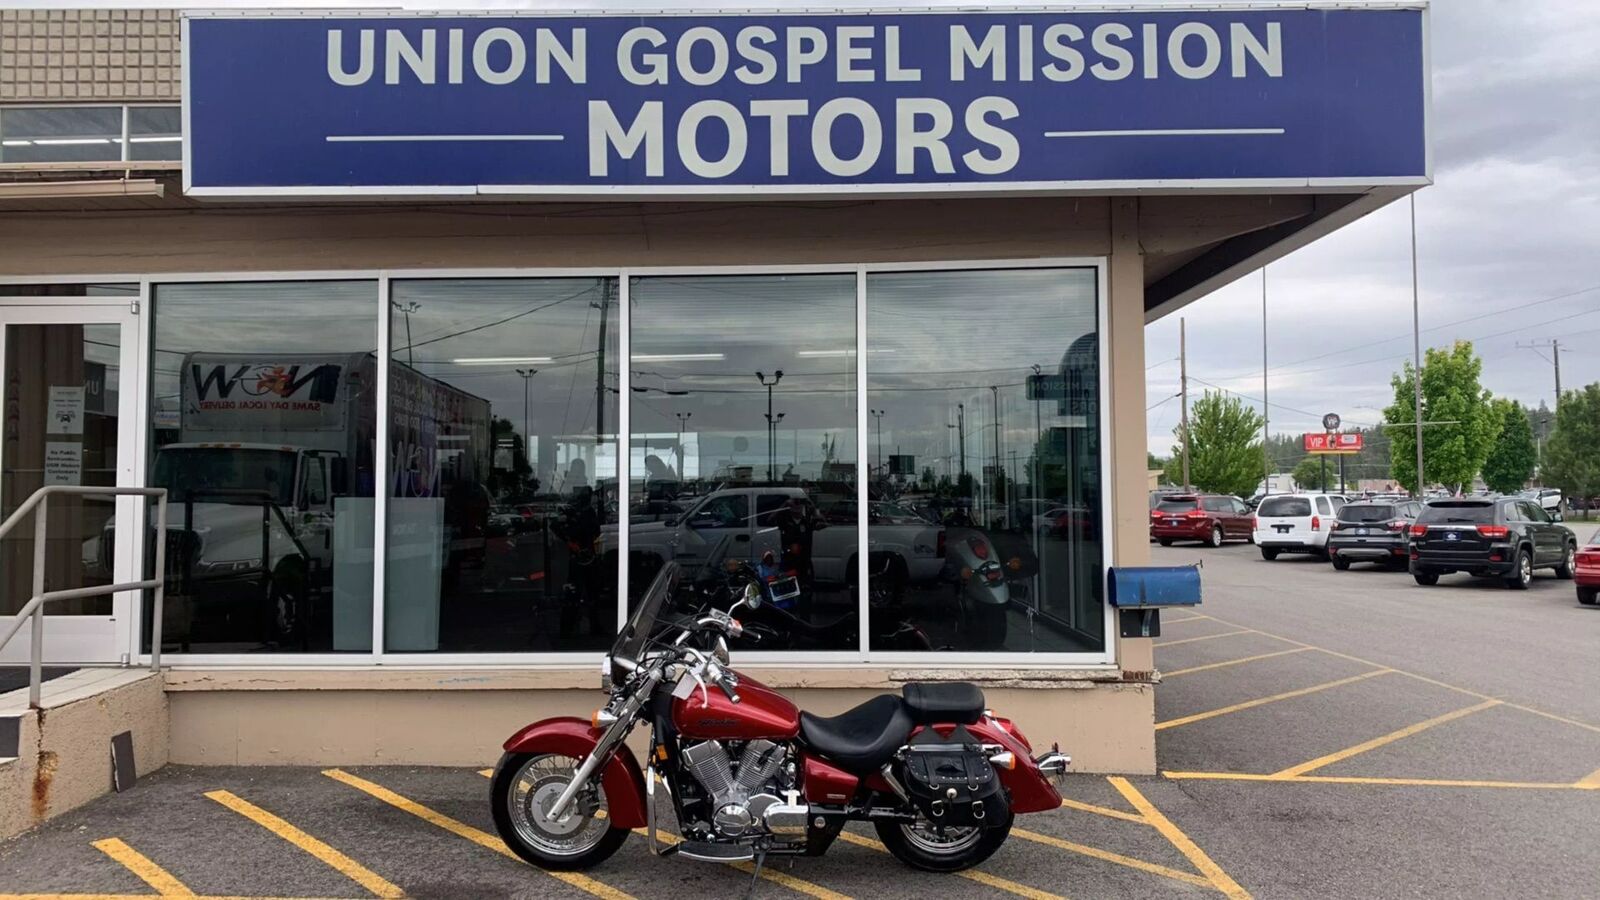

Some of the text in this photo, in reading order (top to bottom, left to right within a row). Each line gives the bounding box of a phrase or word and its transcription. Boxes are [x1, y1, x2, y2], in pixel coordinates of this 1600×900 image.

[327, 21, 1284, 86] UNION GOSPEL MISSION
[588, 95, 1021, 179] MOTORS
[1310, 437, 1324, 448] VIP
